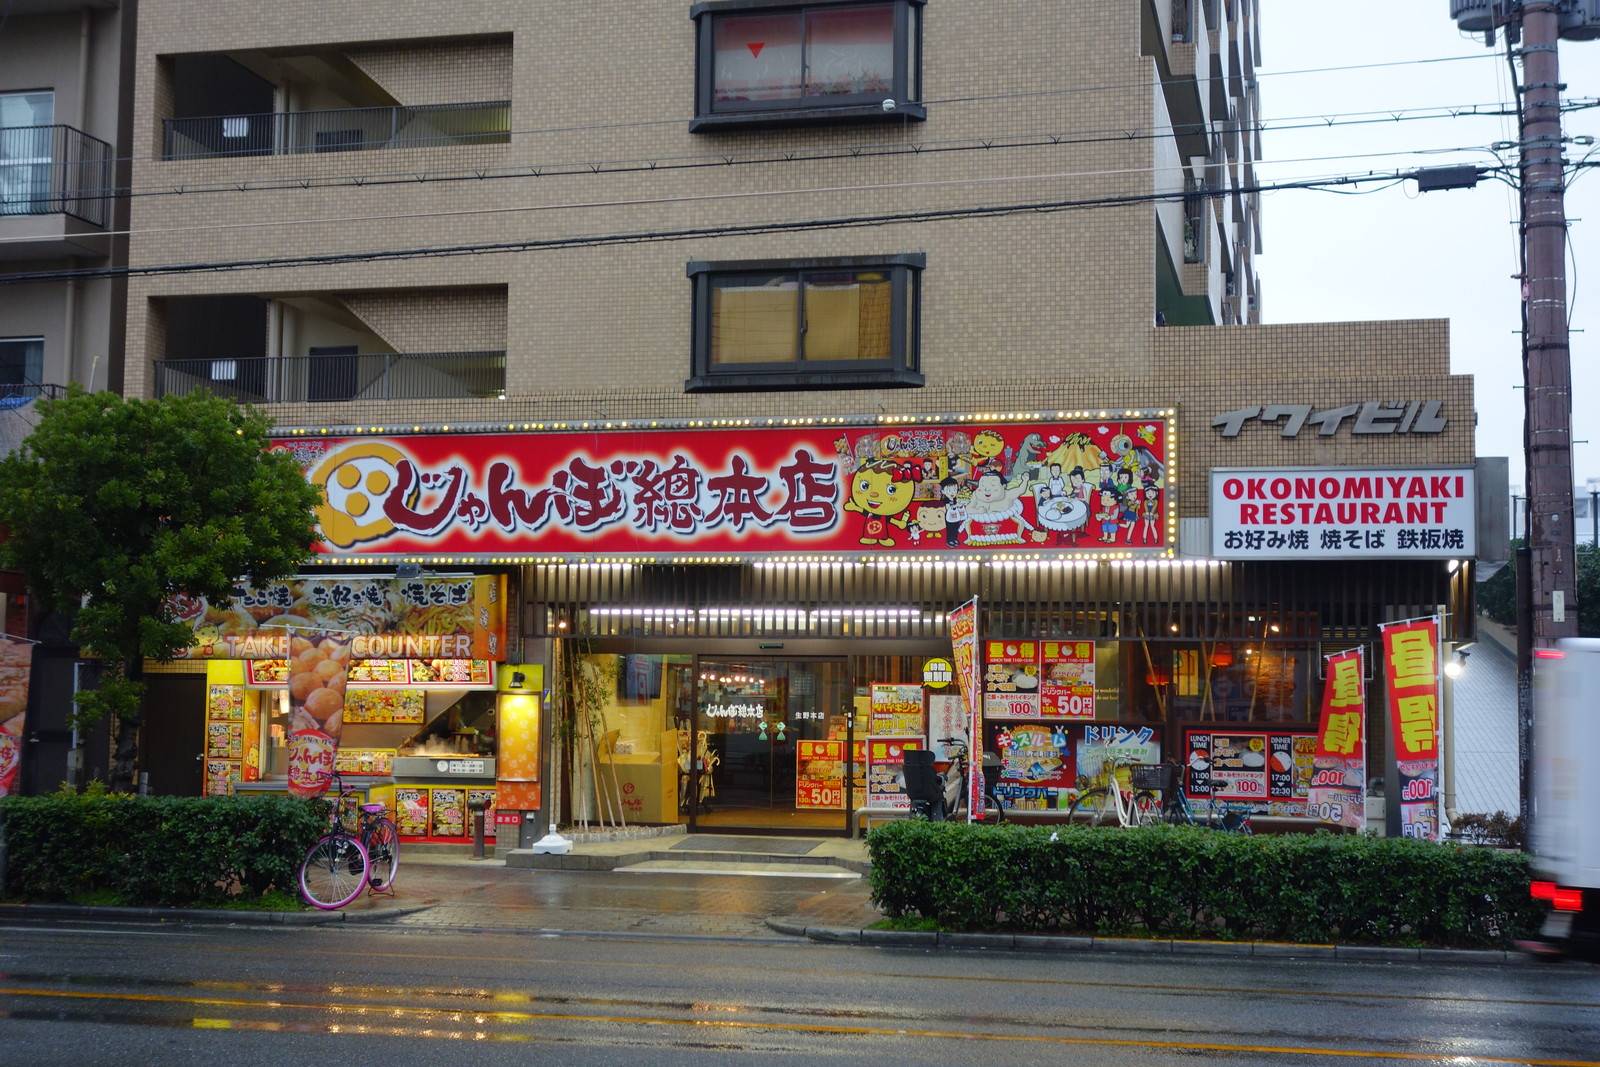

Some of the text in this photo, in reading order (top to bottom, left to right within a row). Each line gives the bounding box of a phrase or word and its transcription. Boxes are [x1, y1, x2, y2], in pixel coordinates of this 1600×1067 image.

[1211, 400, 1448, 437] イワイビル
[1222, 476, 1464, 500] OKONOMIYAKI
[1240, 502, 1448, 525] RESTAURANT
[1224, 528, 1464, 549] お好み焼 焼そば 鉄板焼
[401, 581, 472, 606] 焼そば
[226, 635, 289, 657] TAKE
[351, 634, 472, 658] COUNTER
[995, 732, 1067, 750] キッズルーム
[1084, 725, 1154, 746] ドリンク
[1191, 785, 1210, 793] 15:00
[1271, 787, 1290, 795] 22:30
